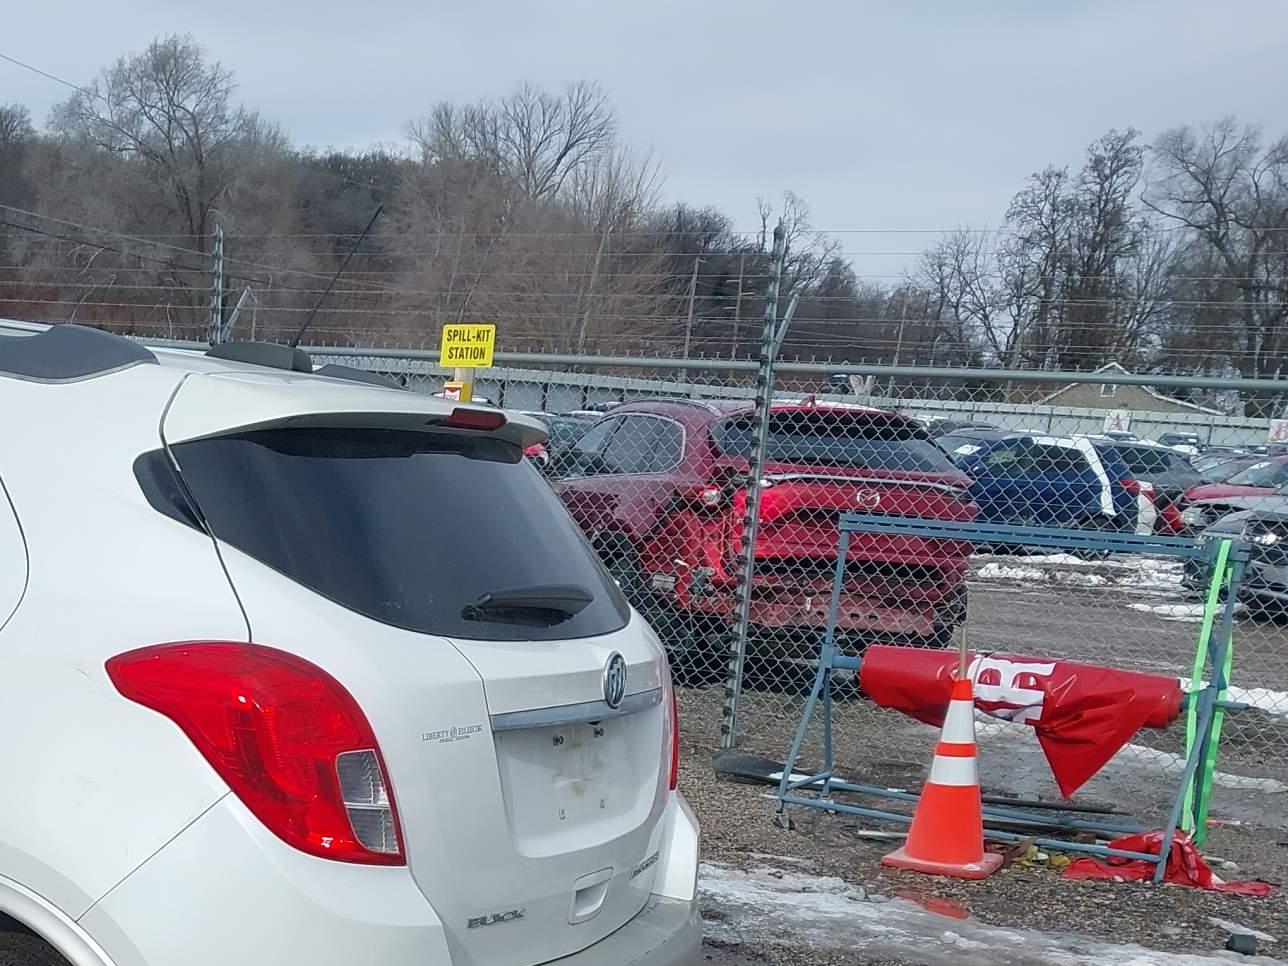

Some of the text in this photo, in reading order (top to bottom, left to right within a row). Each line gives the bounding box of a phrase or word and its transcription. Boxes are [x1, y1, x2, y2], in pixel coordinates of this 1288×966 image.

[446, 328, 491, 343] SPILL-KIT
[447, 346, 486, 360] STATION
[421, 730, 449, 742] LIBERTY
[458, 724, 483, 736] BUICK
[466, 908, 526, 928] BUICK
